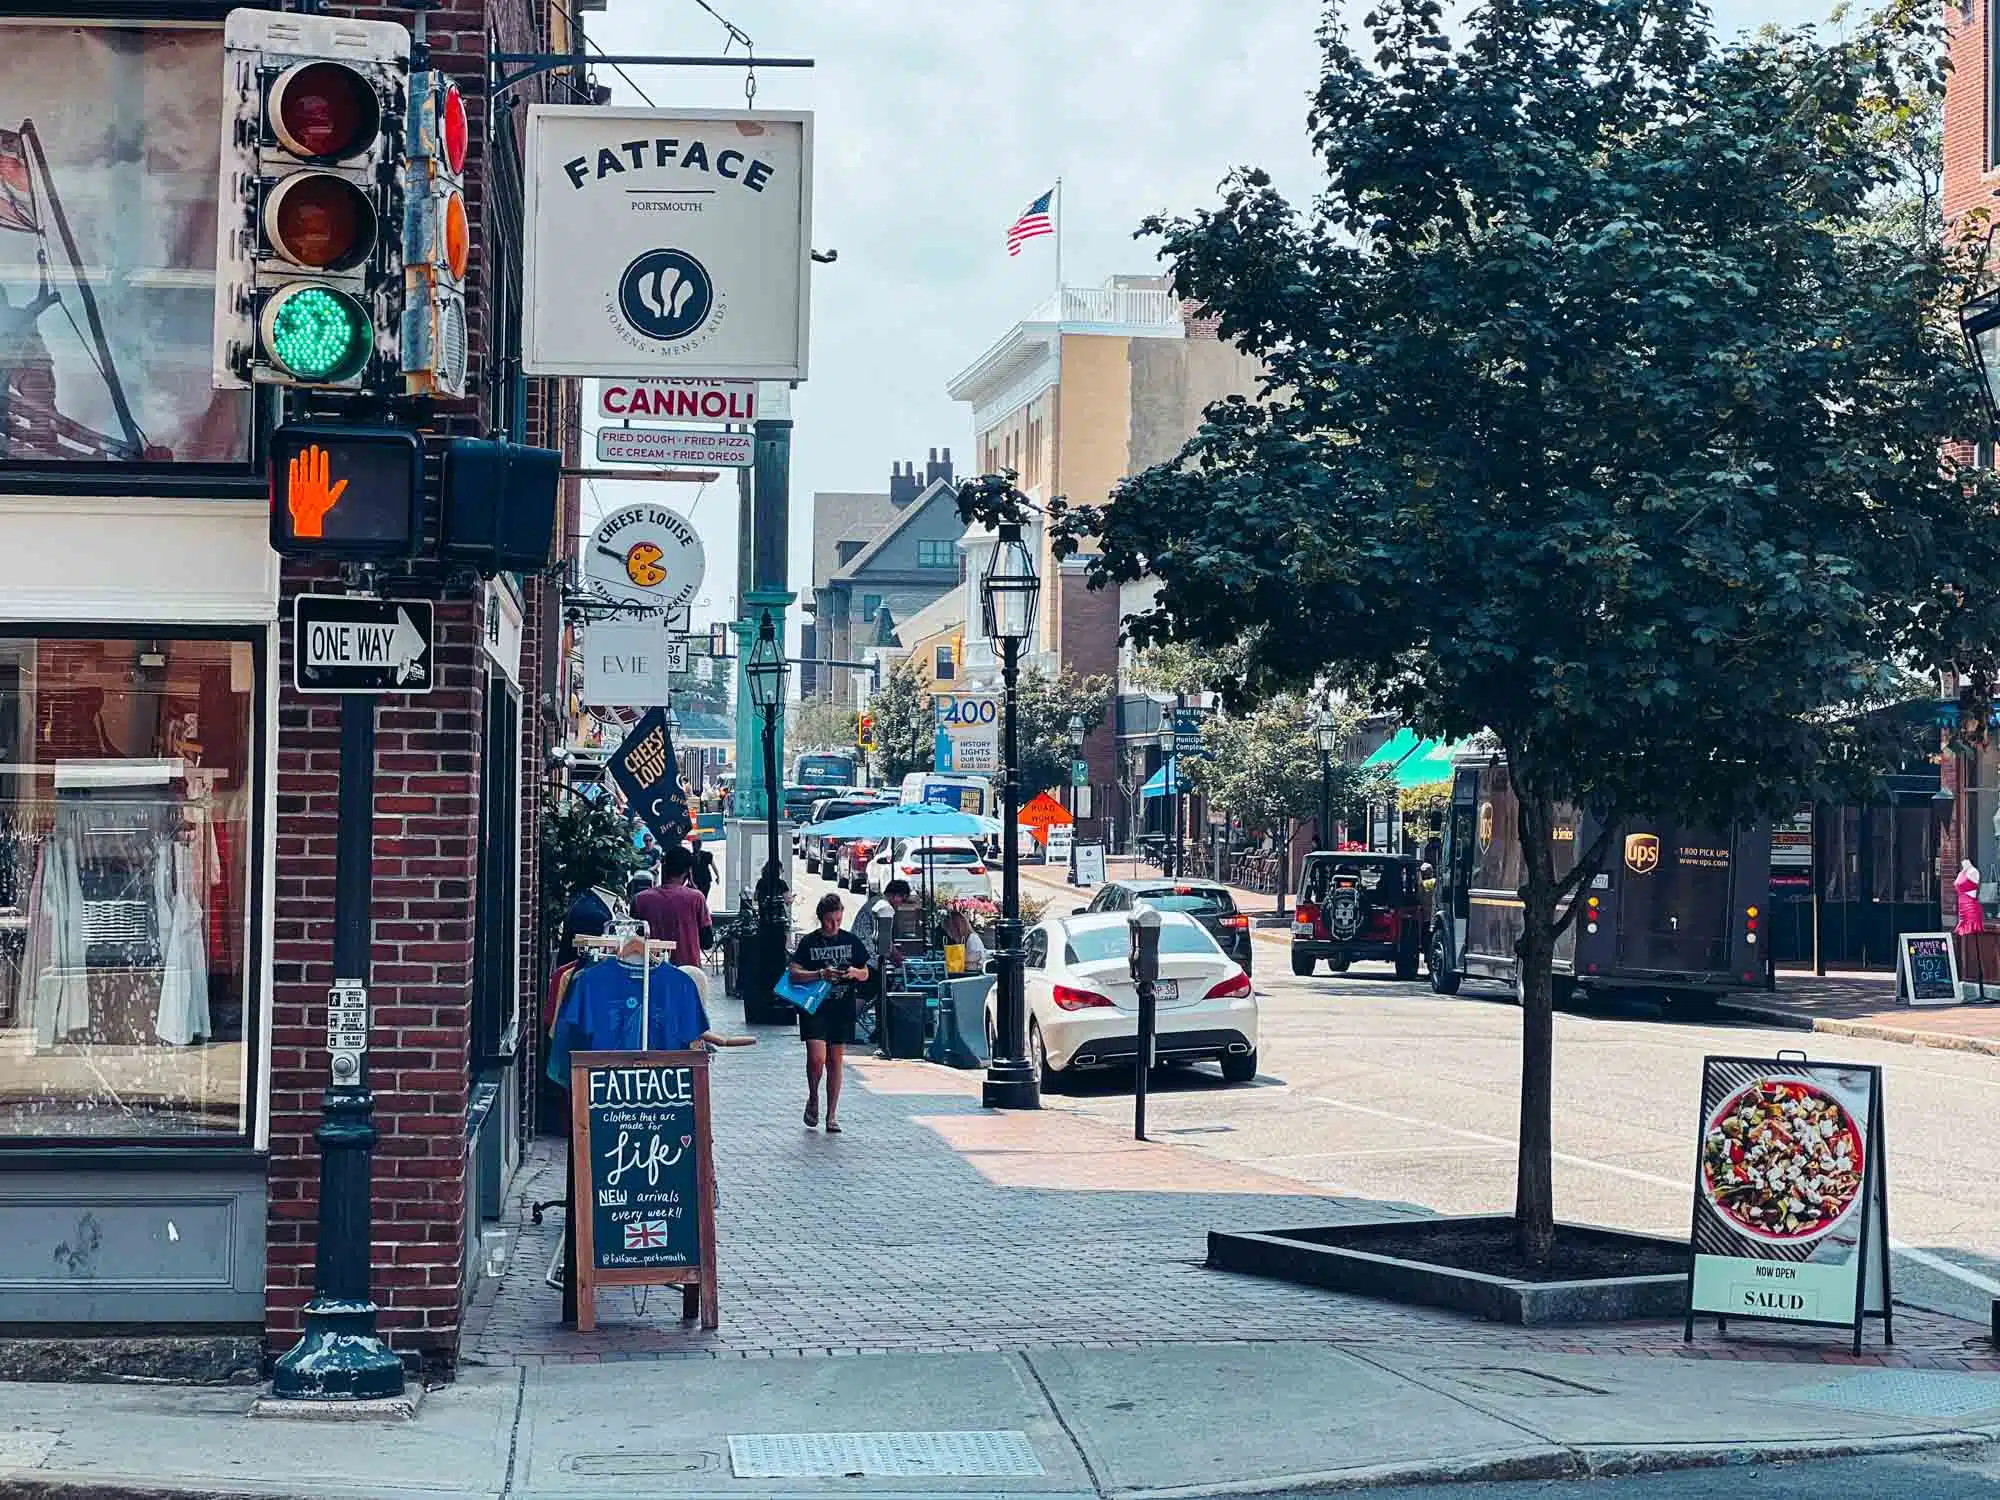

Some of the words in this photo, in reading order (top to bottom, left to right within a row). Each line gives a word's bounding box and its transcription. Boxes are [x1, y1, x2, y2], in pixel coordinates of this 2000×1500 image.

[563, 139, 774, 193] FATFACE
[631, 201, 702, 212] PORTSMOUTH
[605, 303, 647, 352] WOMENS
[661, 340, 699, 357] MENS
[706, 303, 728, 334] KIDS
[603, 386, 753, 418] CANNOLI
[602, 432, 634, 442] FRIED
[637, 434, 675, 444] DOUGH
[684, 436, 715, 446] FRIED
[718, 438, 751, 447] PIZZA
[606, 448, 623, 456] ICE
[626, 448, 664, 458] CREAM
[673, 450, 704, 460] FRIED
[708, 451, 745, 461] OREOS
[598, 510, 644, 544] CHEESE
[648, 510, 694, 548] LOUISE
[312, 626, 350, 661] ONE
[357, 628, 395, 661] WAY
[603, 655, 649, 673] EVIE
[960, 748, 990, 756] LIGHTS
[1627, 845, 1657, 868] ups
[1699, 849, 1715, 857] PICK
[1716, 850, 1729, 858] UPS
[1680, 858, 1728, 868] www.ups.com
[1921, 971, 1941, 980] OFF
[590, 1068, 692, 1102] FATFACE
[640, 1112, 657, 1122] that
[660, 1112, 676, 1121] are
[620, 1122, 644, 1130] made
[648, 1122, 663, 1130] for
[604, 1131, 682, 1185] Life
[599, 1189, 628, 1204] NEW
[637, 1190, 679, 1203] arrivals
[612, 1211, 644, 1223] every
[648, 1207, 682, 1219] week!!
[1756, 1265, 1774, 1277] NOW
[1775, 1267, 1796, 1279] OPEN
[1744, 1290, 1804, 1310] SALUD
